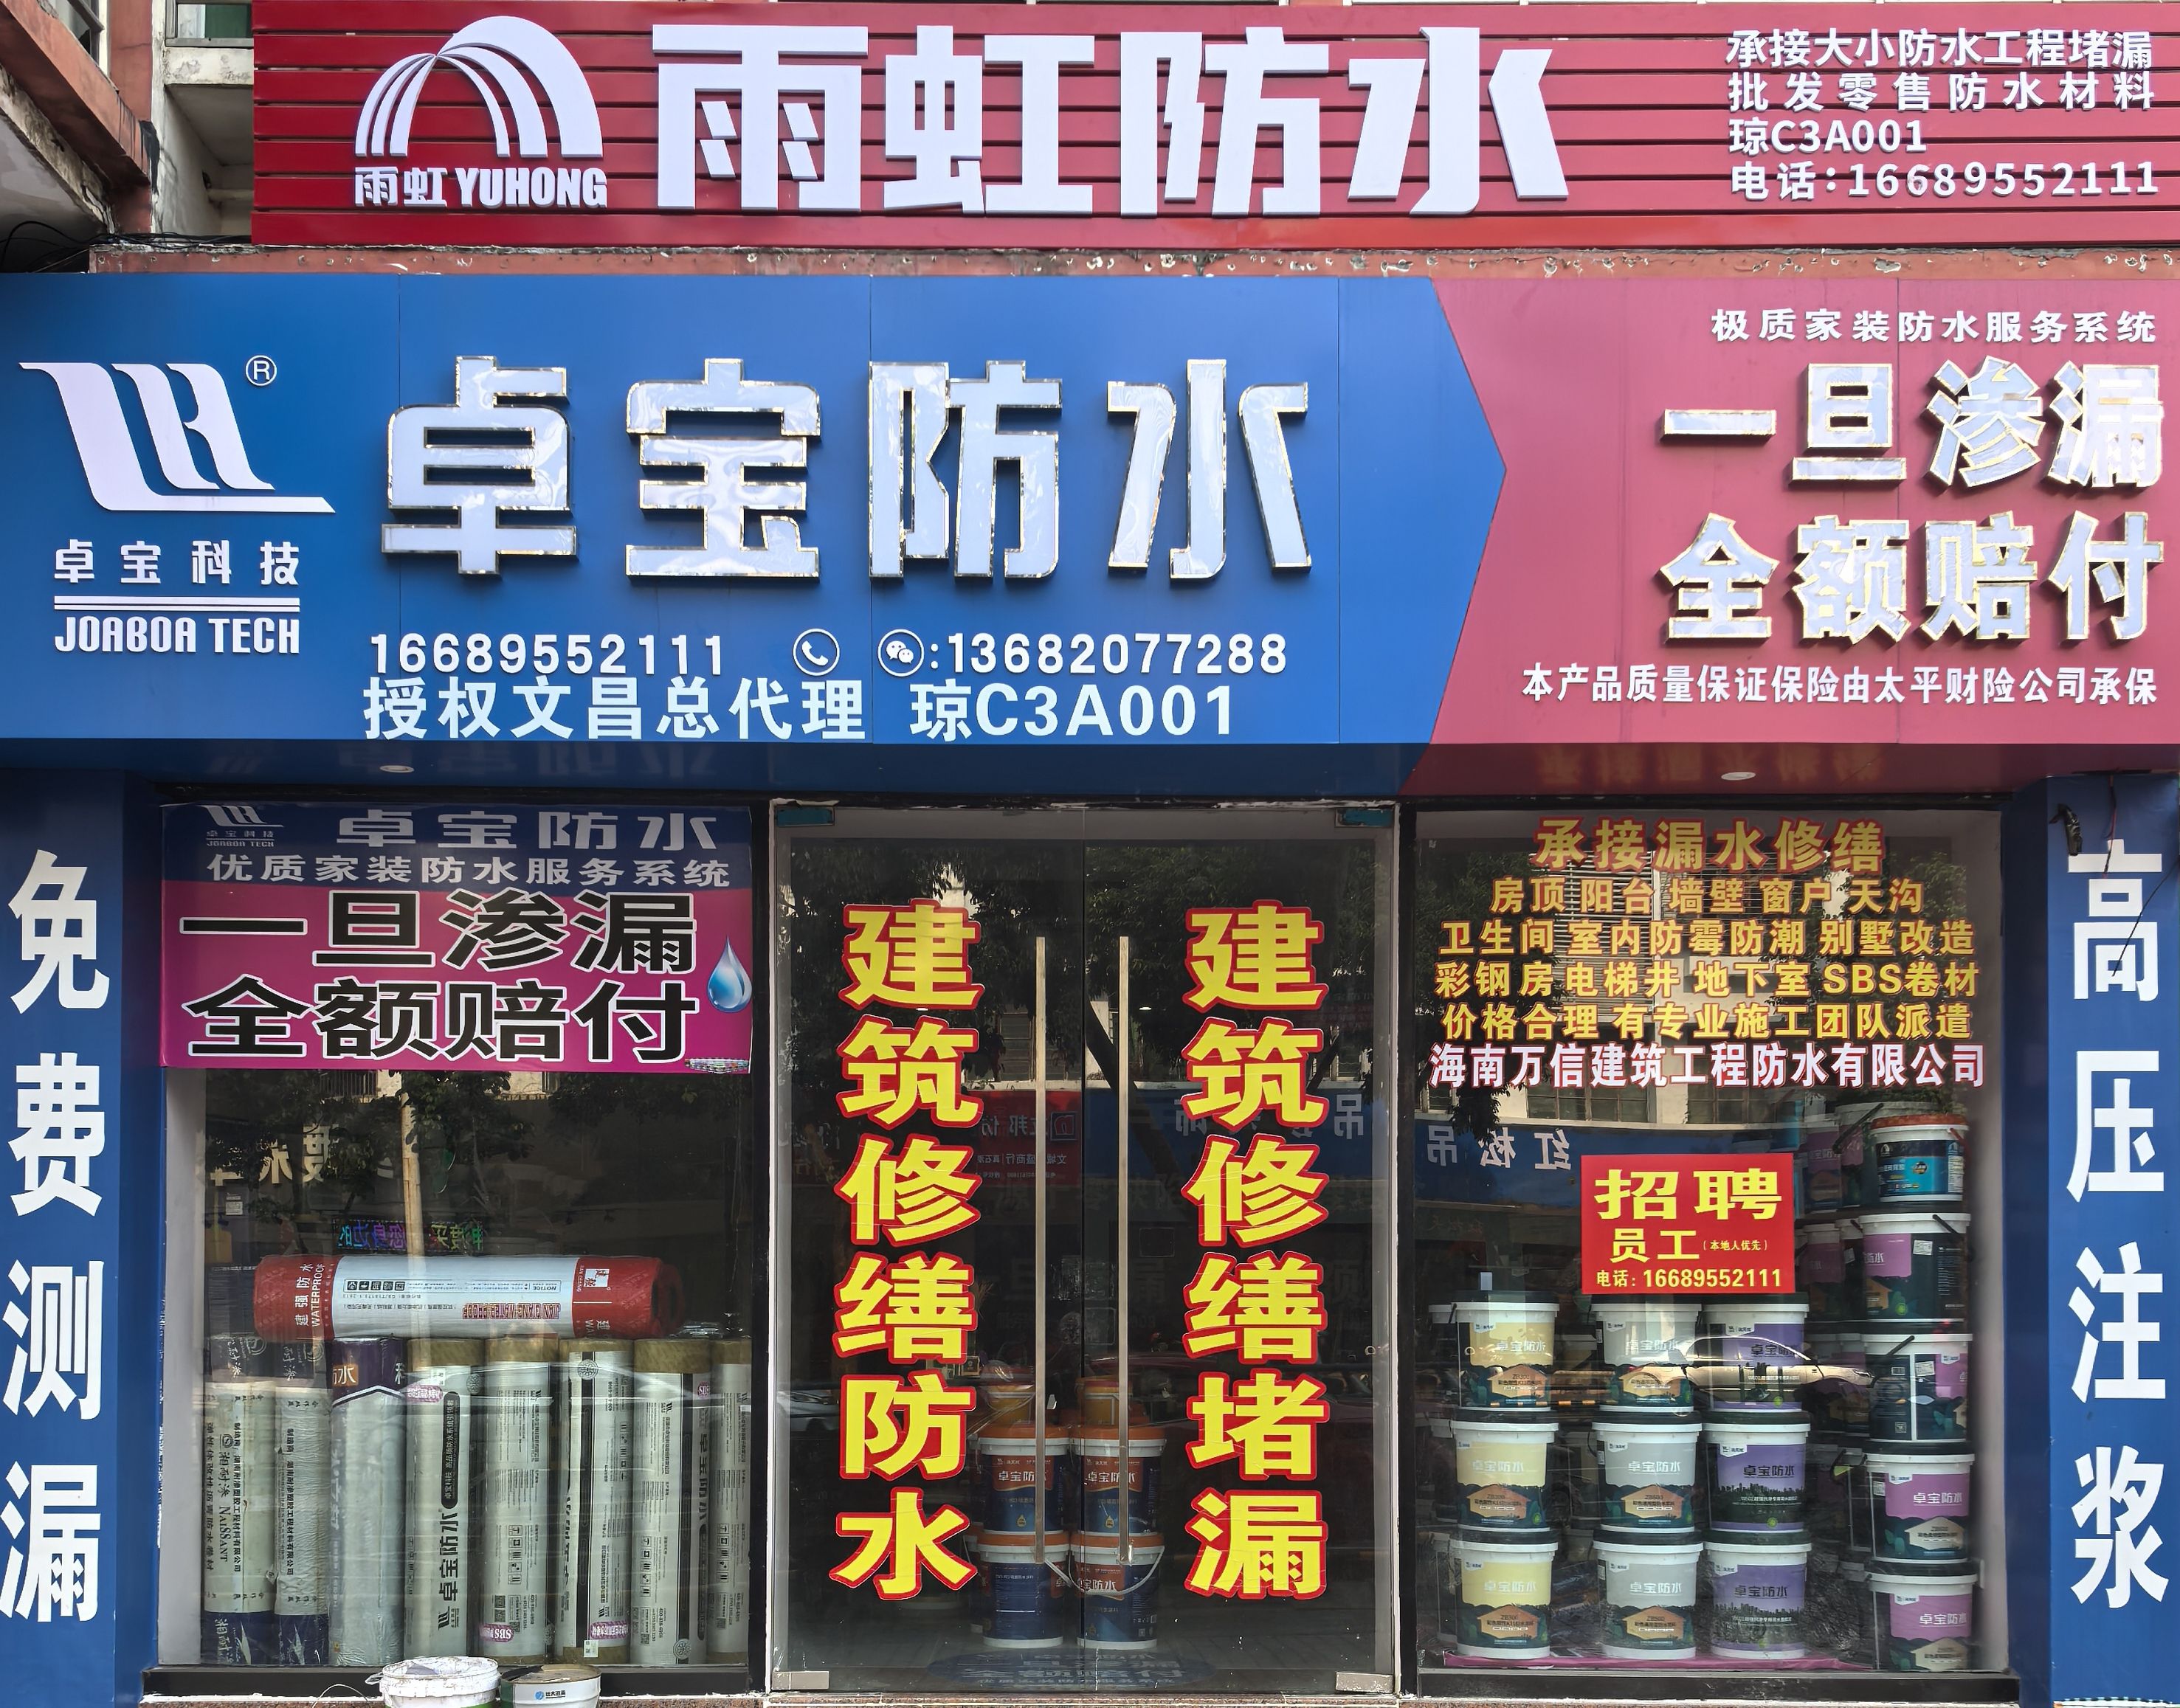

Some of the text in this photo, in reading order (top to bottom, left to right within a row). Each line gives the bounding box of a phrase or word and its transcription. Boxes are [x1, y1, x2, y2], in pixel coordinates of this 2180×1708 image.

[1726, 27, 2153, 69] 承接大小防水工程堵漏
[1728, 72, 2154, 112] 批发零售防水材料
[652, 24, 1569, 217] 雨虹防水
[1728, 117, 1927, 156] 琼C3A001
[355, 166, 607, 208] 雨虹 YUHONG
[1711, 308, 2158, 344] 极质家装防水服务系统
[1660, 355, 2165, 488] 一旦渗漏
[381, 355, 1312, 583] 卓宝防水
[54, 539, 300, 585] 卓宝科技
[1658, 510, 2165, 645] 全额赔付
[54, 615, 300, 654] JOABOA TECH
[369, 634, 724, 676] 16689552111
[1522, 663, 2159, 705] 本产品质量保证保险由太平财险公司承保
[362, 677, 1233, 741] 授权文昌总代理 琼C3A001
[337, 810, 717, 851] 卓宝防水
[1531, 815, 1886, 874] 承接漏水修缮
[207, 854, 730, 887] 优质家装防水服务系统
[1490, 878, 1923, 914] 房顶 阳台 墙壁 窗户 天沟
[179, 888, 697, 974] 一旦渗漏
[1439, 918, 1976, 956] 卫生间 室内防霉防潮 别墅改造
[1694, 961, 1810, 998] 地下室
[1823, 961, 1980, 998] SBS卷材
[182, 974, 700, 1064] 全额赔付
[1441, 1003, 1973, 1041] 价格合理 有专业施工团队派遣
[1429, 1043, 1985, 1090] 海南万信建筑工程防水有限公司
[1594, 1168, 1782, 1220] 招聘
[0, 849, 110, 1622] 免费测漏
[2066, 840, 2169, 1608] 高压注浆
[829, 898, 985, 1600] 建筑修缮防水
[1180, 898, 1329, 1600] 建筑修缮堵漏
[1609, 1228, 1700, 1263] 员工
[1628, 1461, 1680, 1473] 卓宝防水
[1743, 1465, 1795, 1476] 卓宝防水
[1913, 1492, 1962, 1504] 卓宝防水
[439, 1512, 459, 1602] 卓宝防水
[1629, 1582, 1682, 1594] 卓宝防水
[1734, 1585, 1787, 1597] 卓宝防水
